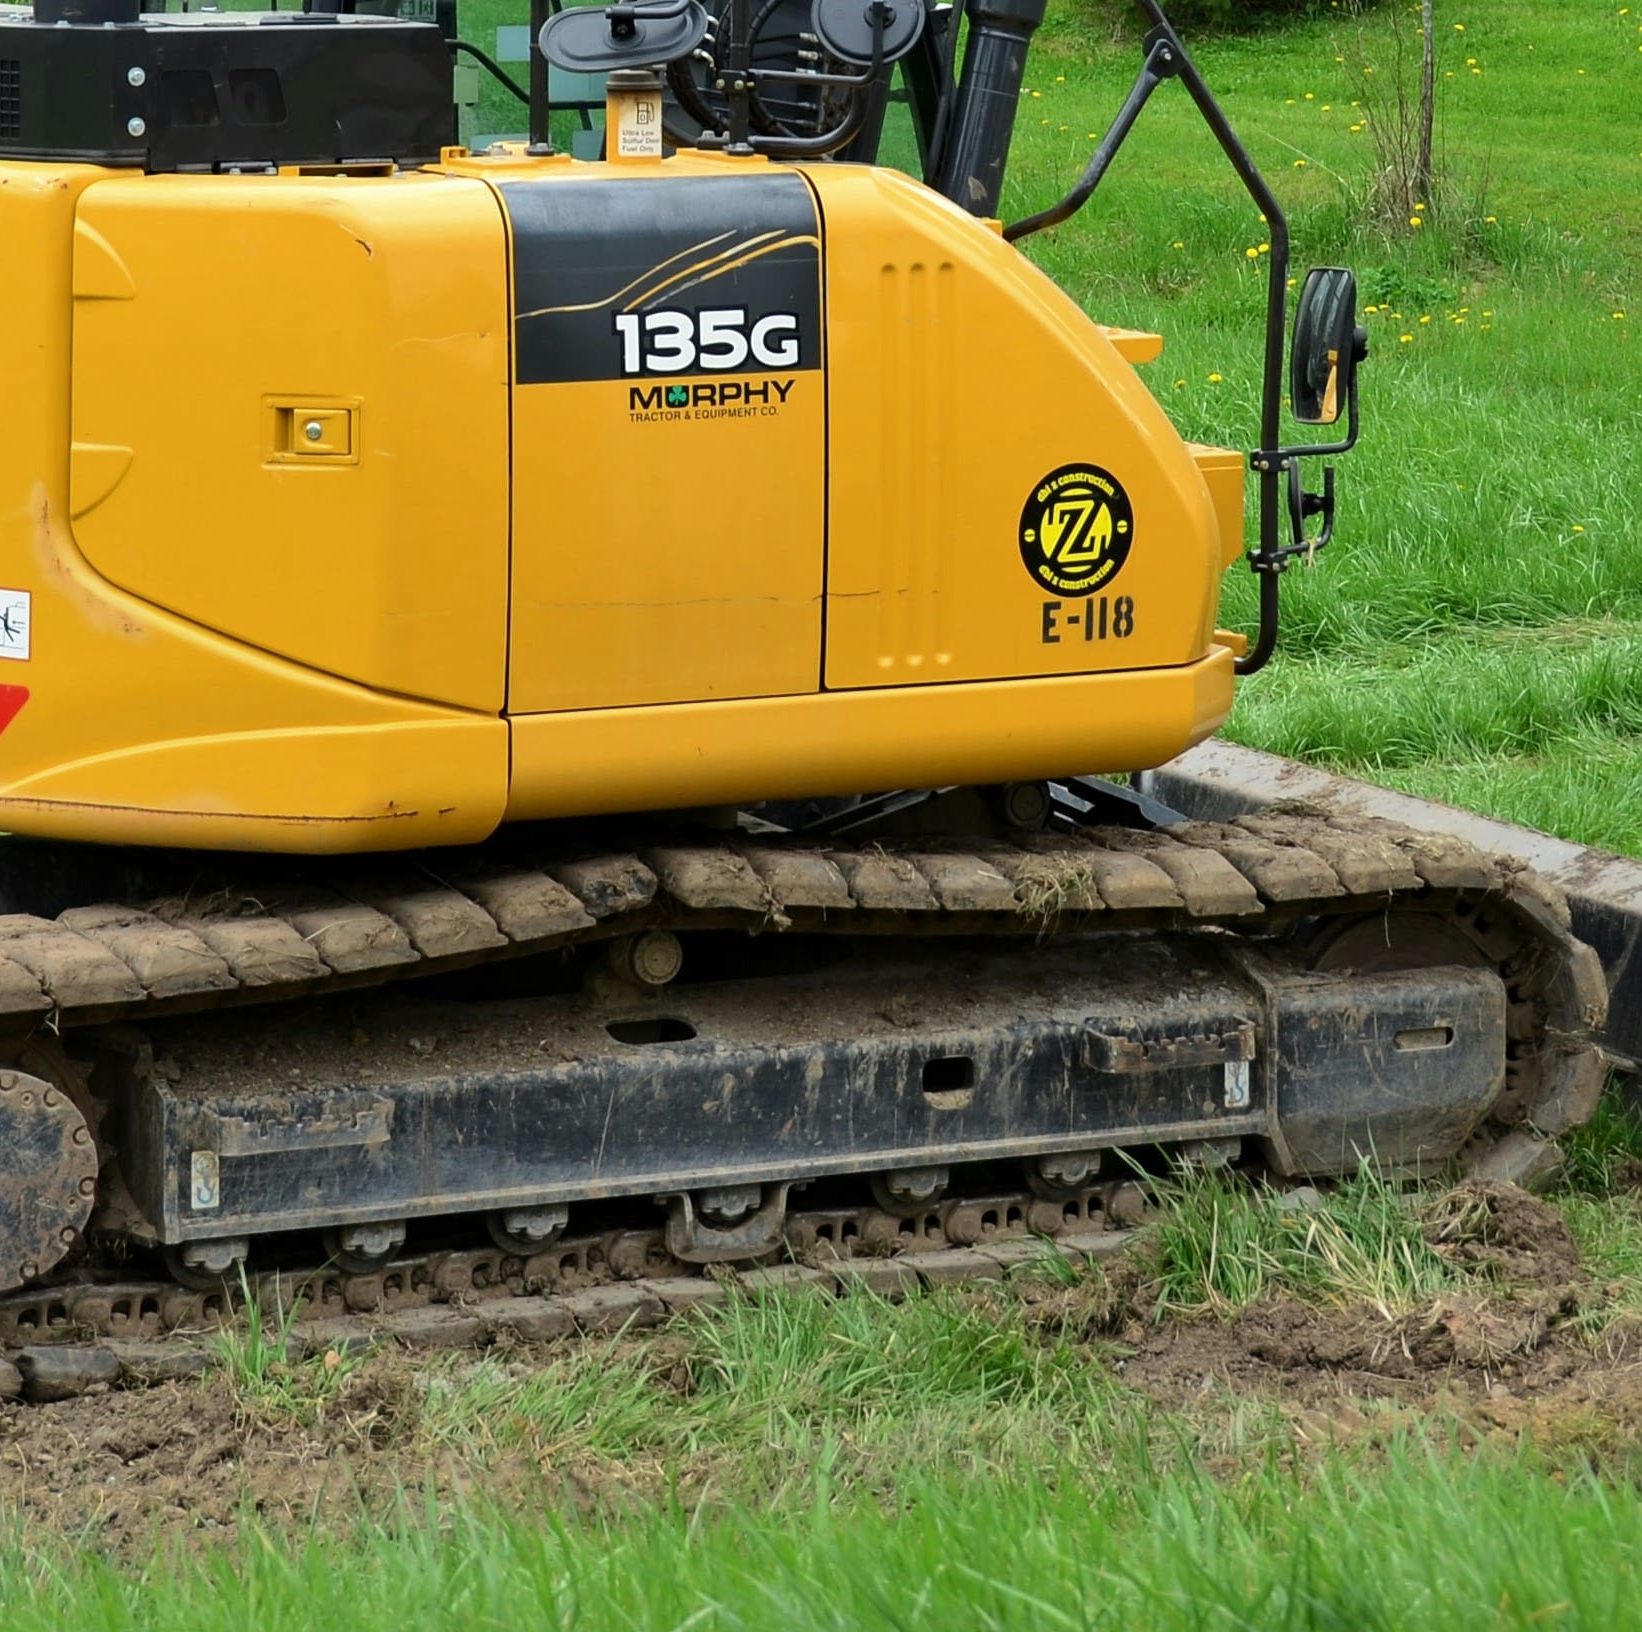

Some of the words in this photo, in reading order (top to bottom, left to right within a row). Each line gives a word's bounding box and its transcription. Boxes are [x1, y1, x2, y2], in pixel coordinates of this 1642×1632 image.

[639, 145, 654, 153] Only
[615, 309, 799, 373] 135G
[629, 379, 796, 411] MURPHY
[629, 410, 681, 423] TRACTOR
[684, 409, 692, 420] &
[694, 407, 758, 419] EQUIPMENT
[760, 406, 779, 417] CO.
[1058, 472, 1115, 496] construction
[1058, 558, 1115, 590] construction
[1042, 595, 1134, 644] E-118
